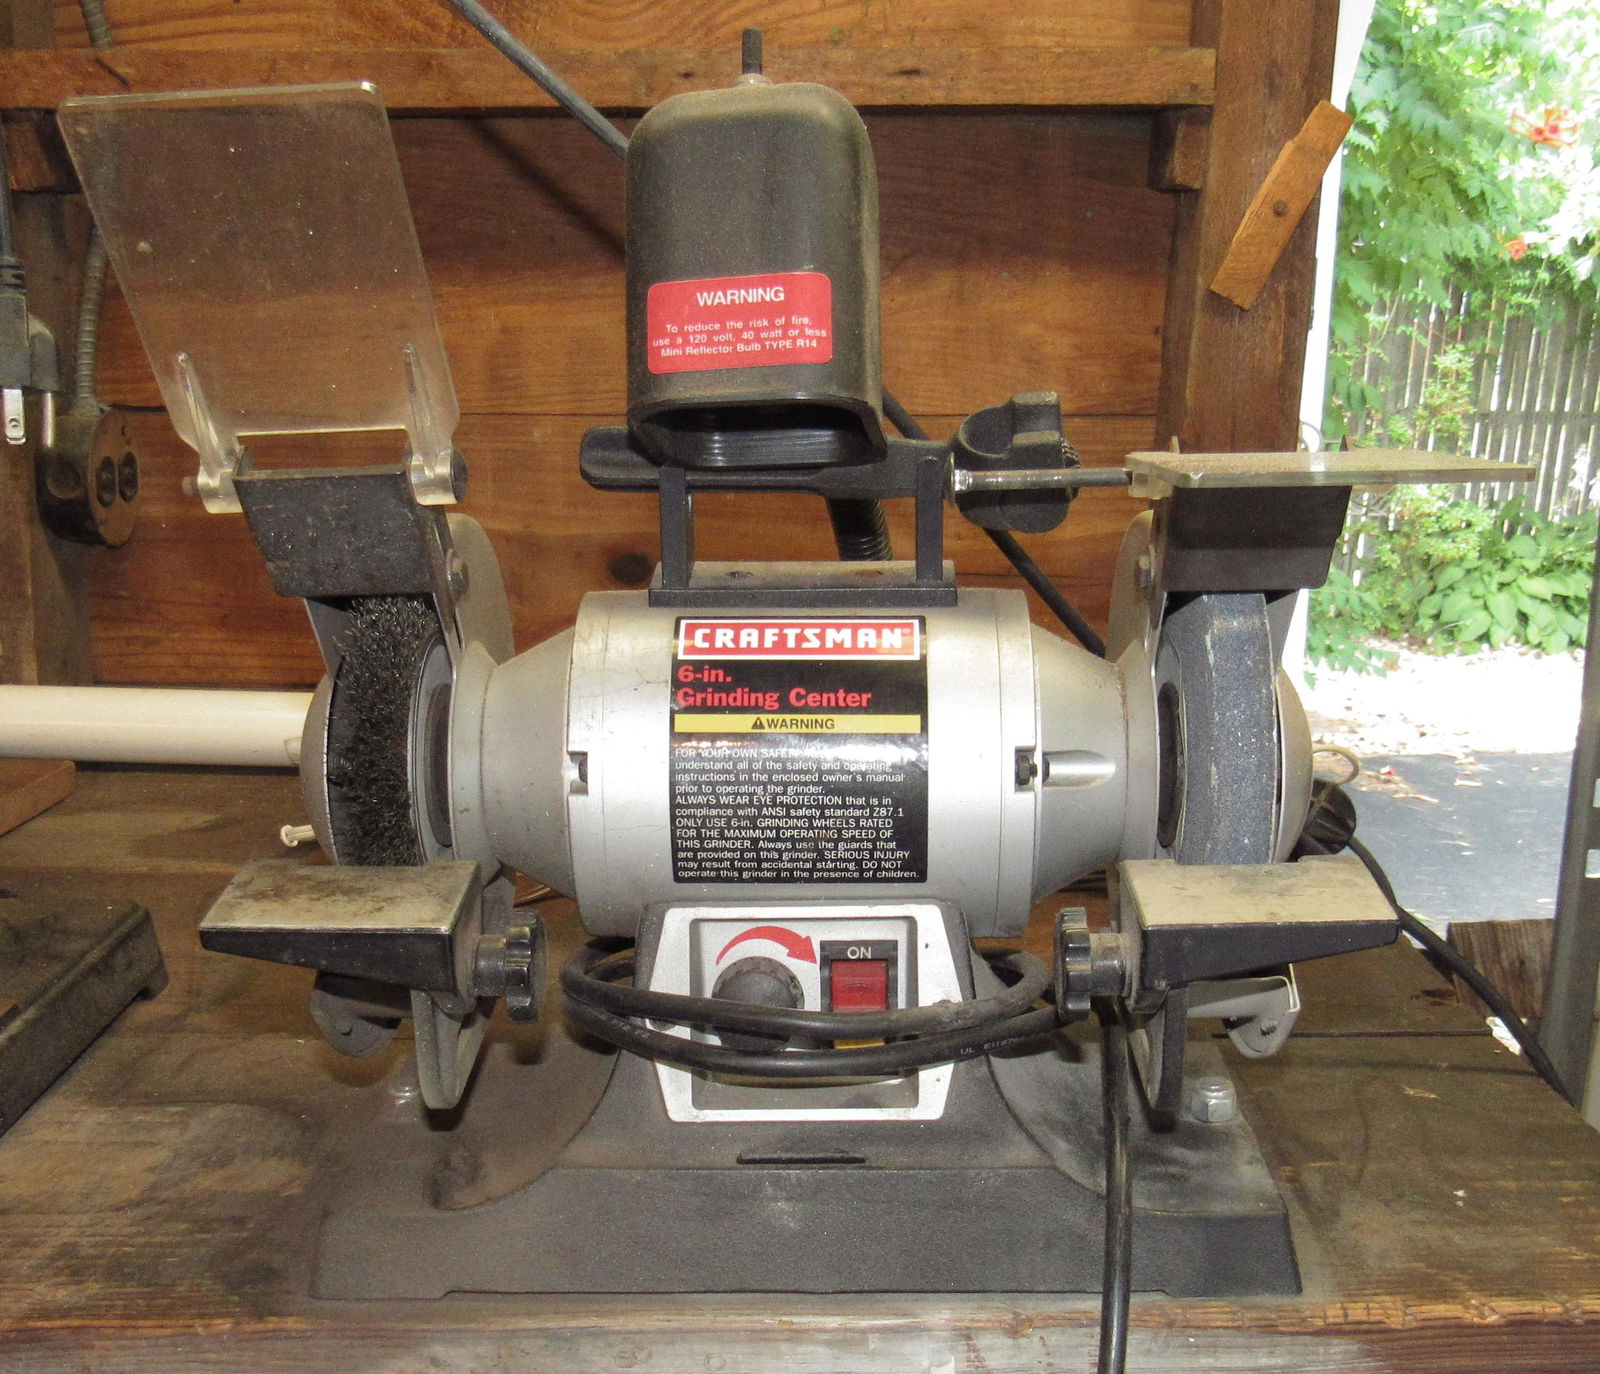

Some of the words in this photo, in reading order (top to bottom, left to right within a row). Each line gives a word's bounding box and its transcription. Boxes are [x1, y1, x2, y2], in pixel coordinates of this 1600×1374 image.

[697, 287, 784, 306] WARNING
[666, 324, 678, 333] To
[684, 323, 720, 332] reduce
[727, 320, 743, 329] the
[749, 318, 768, 328] risk
[775, 316, 785, 326] of
[653, 338, 670, 346] use
[690, 334, 707, 343] 120
[742, 331, 754, 339] 40
[760, 330, 782, 338] watt
[805, 328, 826, 337] less
[661, 348, 682, 357] Mini
[686, 346, 733, 355] Reflector
[737, 343, 761, 352] Bulb
[765, 340, 793, 350] TYPE
[797, 339, 817, 348] R14
[694, 628, 902, 648] CRAFTSMAN
[677, 664, 732, 682] 6-in.
[677, 688, 780, 710] Grinding
[790, 688, 871, 707] Center
[766, 718, 835, 729] WARNING
[676, 748, 696, 758] FOR
[733, 748, 757, 758] OWN
[676, 761, 733, 770] understand
[737, 761, 748, 770] all
[752, 761, 762, 770] of
[766, 761, 782, 770] the
[786, 761, 817, 772] safety
[821, 761, 840, 770] and
[844, 762, 892, 772] operating
[676, 772, 735, 781] instructions
[740, 772, 748, 781] in
[752, 772, 768, 781] the
[772, 772, 818, 781] enclosed
[822, 772, 862, 782] owner's
[866, 772, 904, 782] manual
[676, 784, 698, 794] prior
[702, 785, 712, 793] to
[716, 784, 764, 795] operating
[768, 784, 783, 793] the
[788, 784, 825, 795] grinder.
[676, 796, 716, 805] ALWAYS
[720, 796, 749, 805] WEAR
[754, 796, 773, 805] EYE
[777, 796, 842, 805] PROTECTION
[846, 796, 866, 805] that
[870, 796, 878, 805] is
[882, 796, 891, 805] in
[676, 807, 733, 817] compliance
[737, 807, 758, 816] with
[761, 807, 786, 816] ANSI
[790, 807, 820, 818] safety
[824, 808, 869, 816] standard
[873, 808, 904, 816] Z87.1
[676, 818, 702, 827] ONLY
[706, 818, 727, 827] USE
[731, 818, 753, 827] 6-in.
[757, 818, 808, 827] GRINDING
[812, 819, 856, 828] WHEELS
[860, 819, 893, 828] RATED
[676, 829, 696, 838] FOR
[700, 829, 720, 838] THE
[724, 829, 776, 838] MAXIMUM
[780, 830, 838, 838] OPERATING
[842, 830, 876, 838] SPEED
[880, 830, 894, 838] OF
[678, 840, 700, 848] THIS
[704, 840, 754, 848] GRINDER.
[758, 840, 792, 850] Always
[818, 840, 834, 849] the
[838, 840, 873, 850] guards
[877, 841, 896, 849] that
[697, 850, 740, 860] provided
[760, 850, 779, 859] this
[782, 850, 820, 860] grinder.
[824, 851, 870, 859] SERIOUS
[874, 851, 910, 859] INJURY
[678, 862, 698, 870] may
[761, 860, 812, 868] accidental
[816, 861, 858, 870] starting.
[678, 870, 716, 878] operate
[743, 870, 777, 879] grinder
[877, 870, 920, 878] children.
[847, 946, 871, 959] ON
